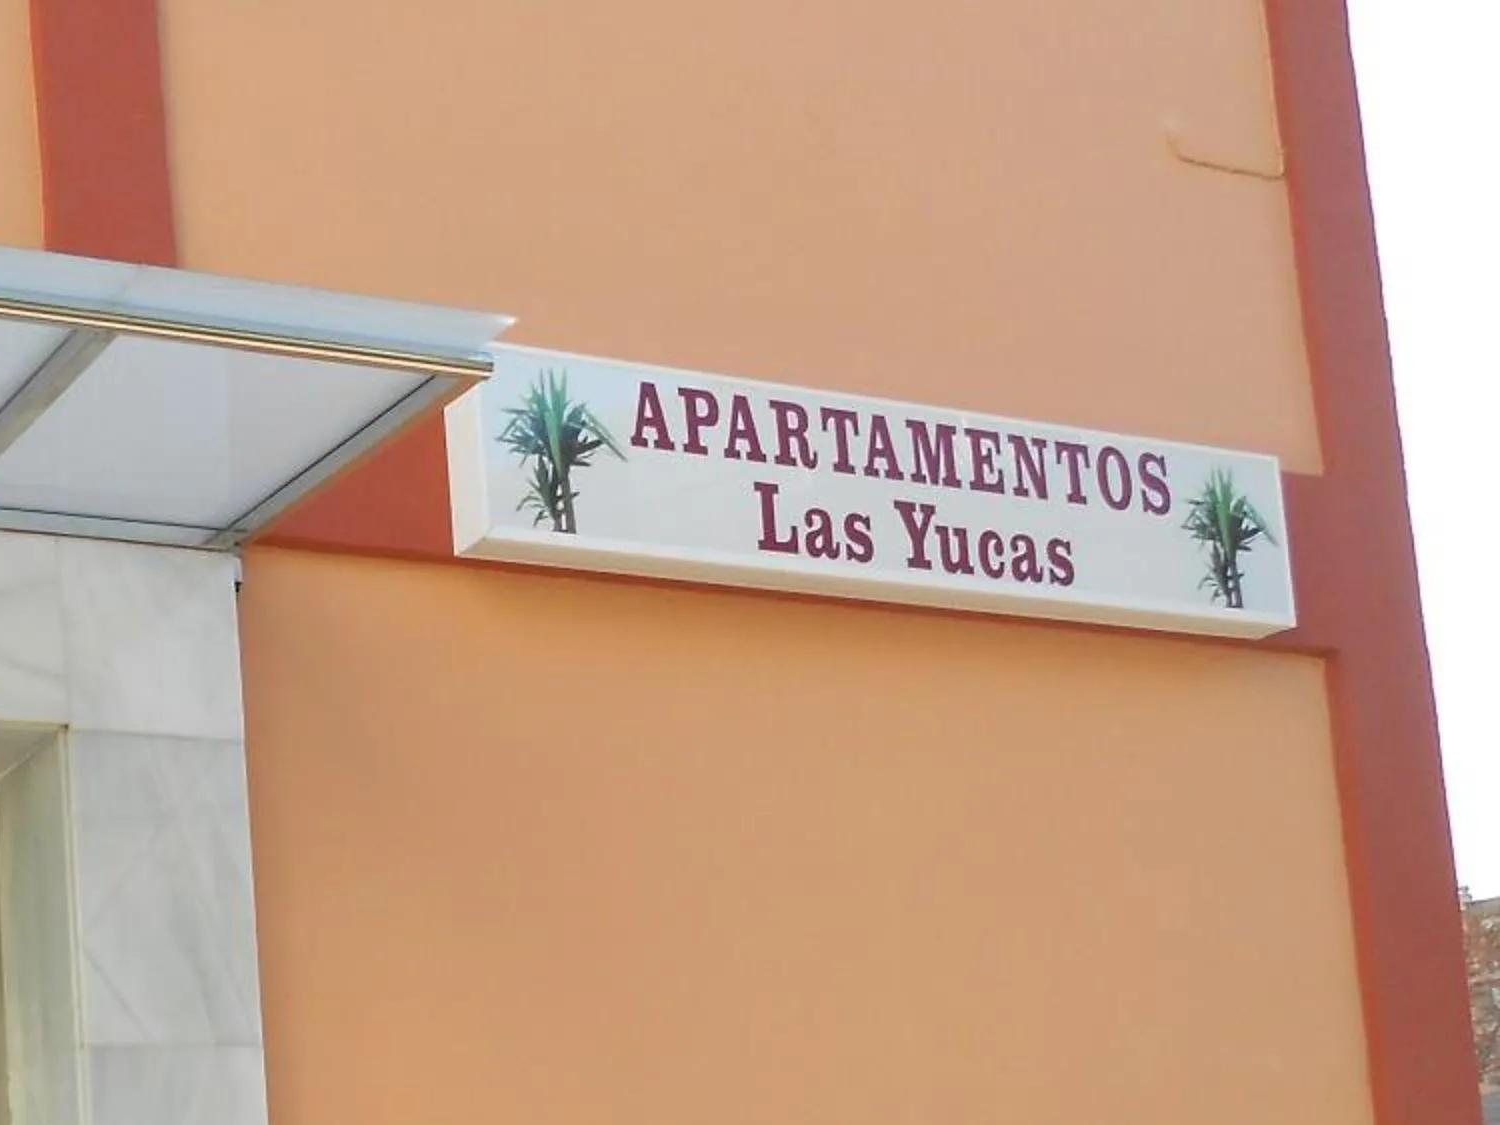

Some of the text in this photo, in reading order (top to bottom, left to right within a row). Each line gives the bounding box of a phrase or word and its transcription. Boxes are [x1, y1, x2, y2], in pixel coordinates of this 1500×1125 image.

[630, 382, 1172, 515] APARTAMENTOS
[754, 482, 1076, 586] Las Yucas
